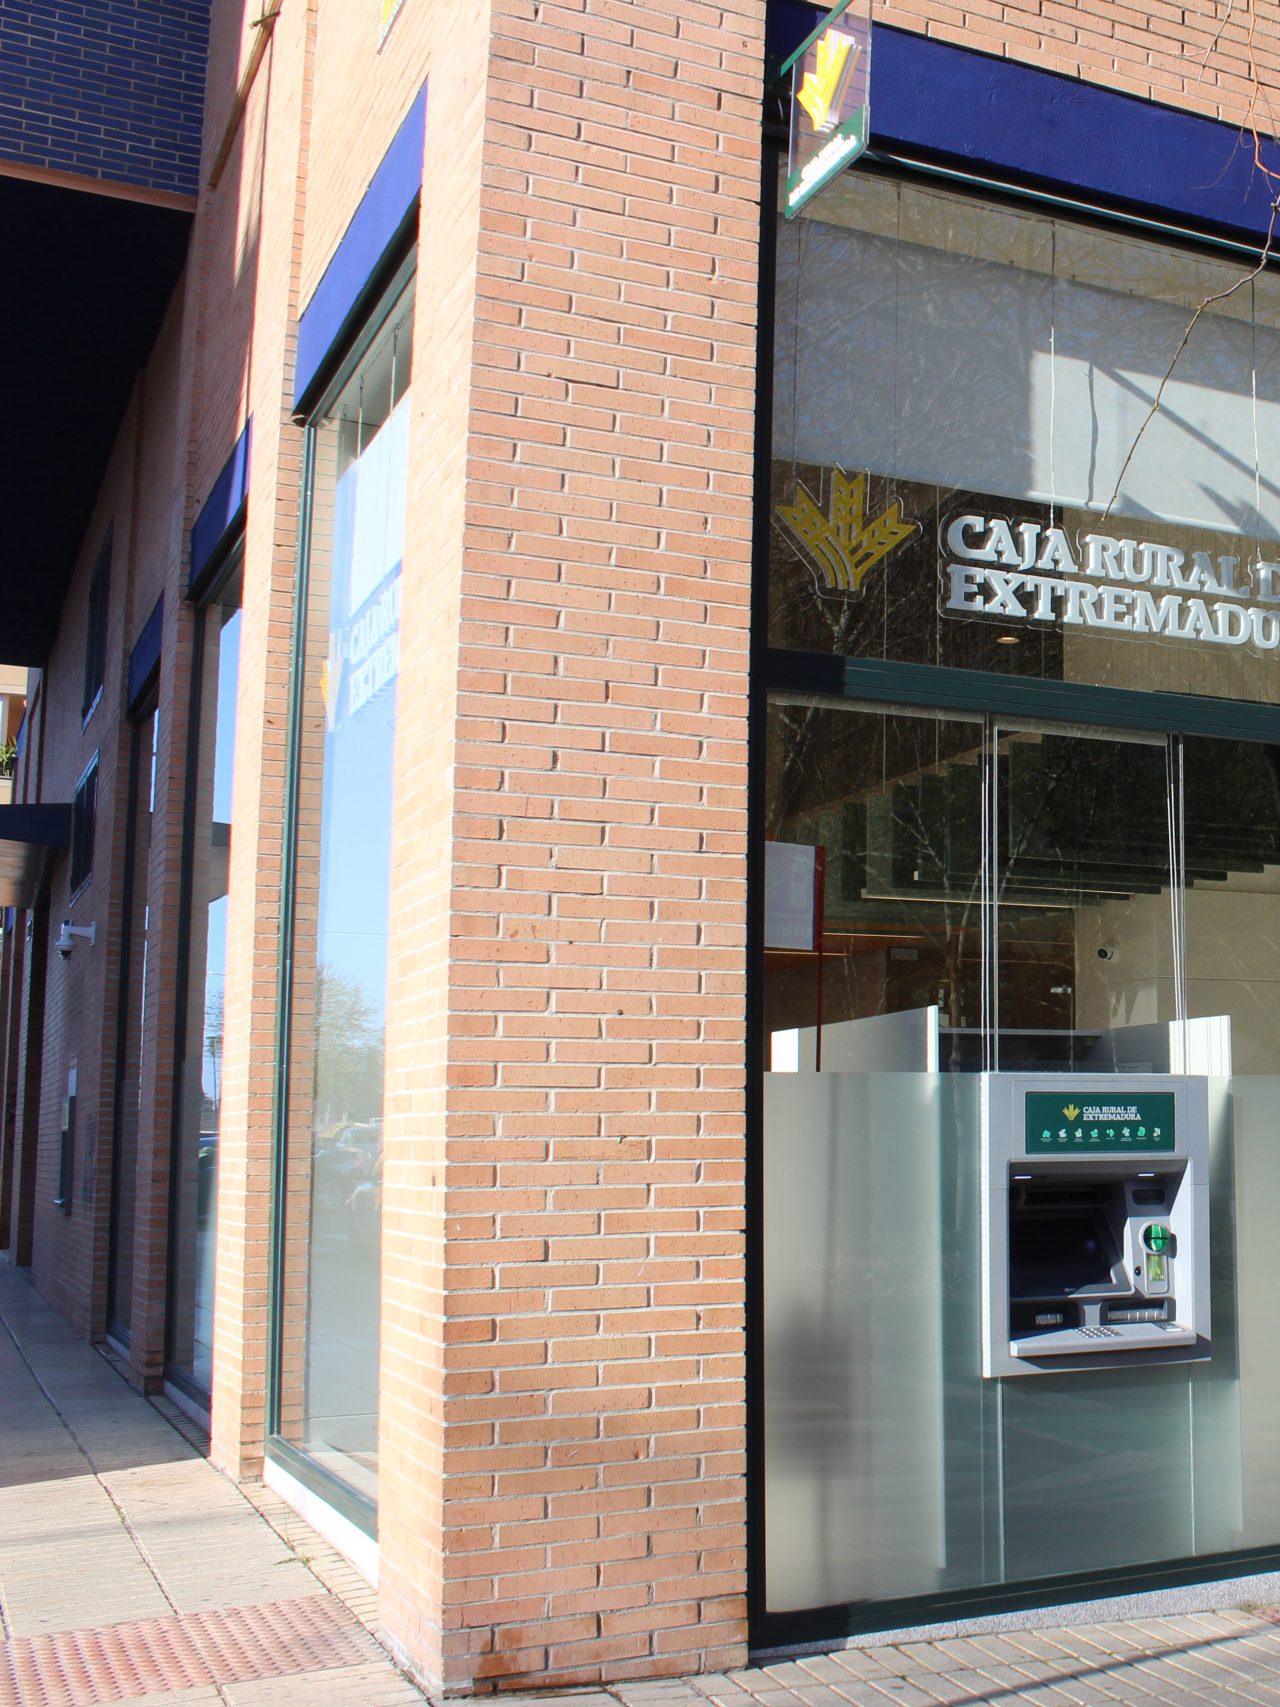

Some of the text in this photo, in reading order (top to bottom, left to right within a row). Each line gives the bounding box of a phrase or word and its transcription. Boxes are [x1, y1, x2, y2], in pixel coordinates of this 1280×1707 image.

[948, 515, 1079, 572] CAJA
[1085, 534, 1250, 599] RURAL
[1082, 1106, 1138, 1114] CAJA RURAL DE
[1082, 1113, 1142, 1121] EXTREMADURA
